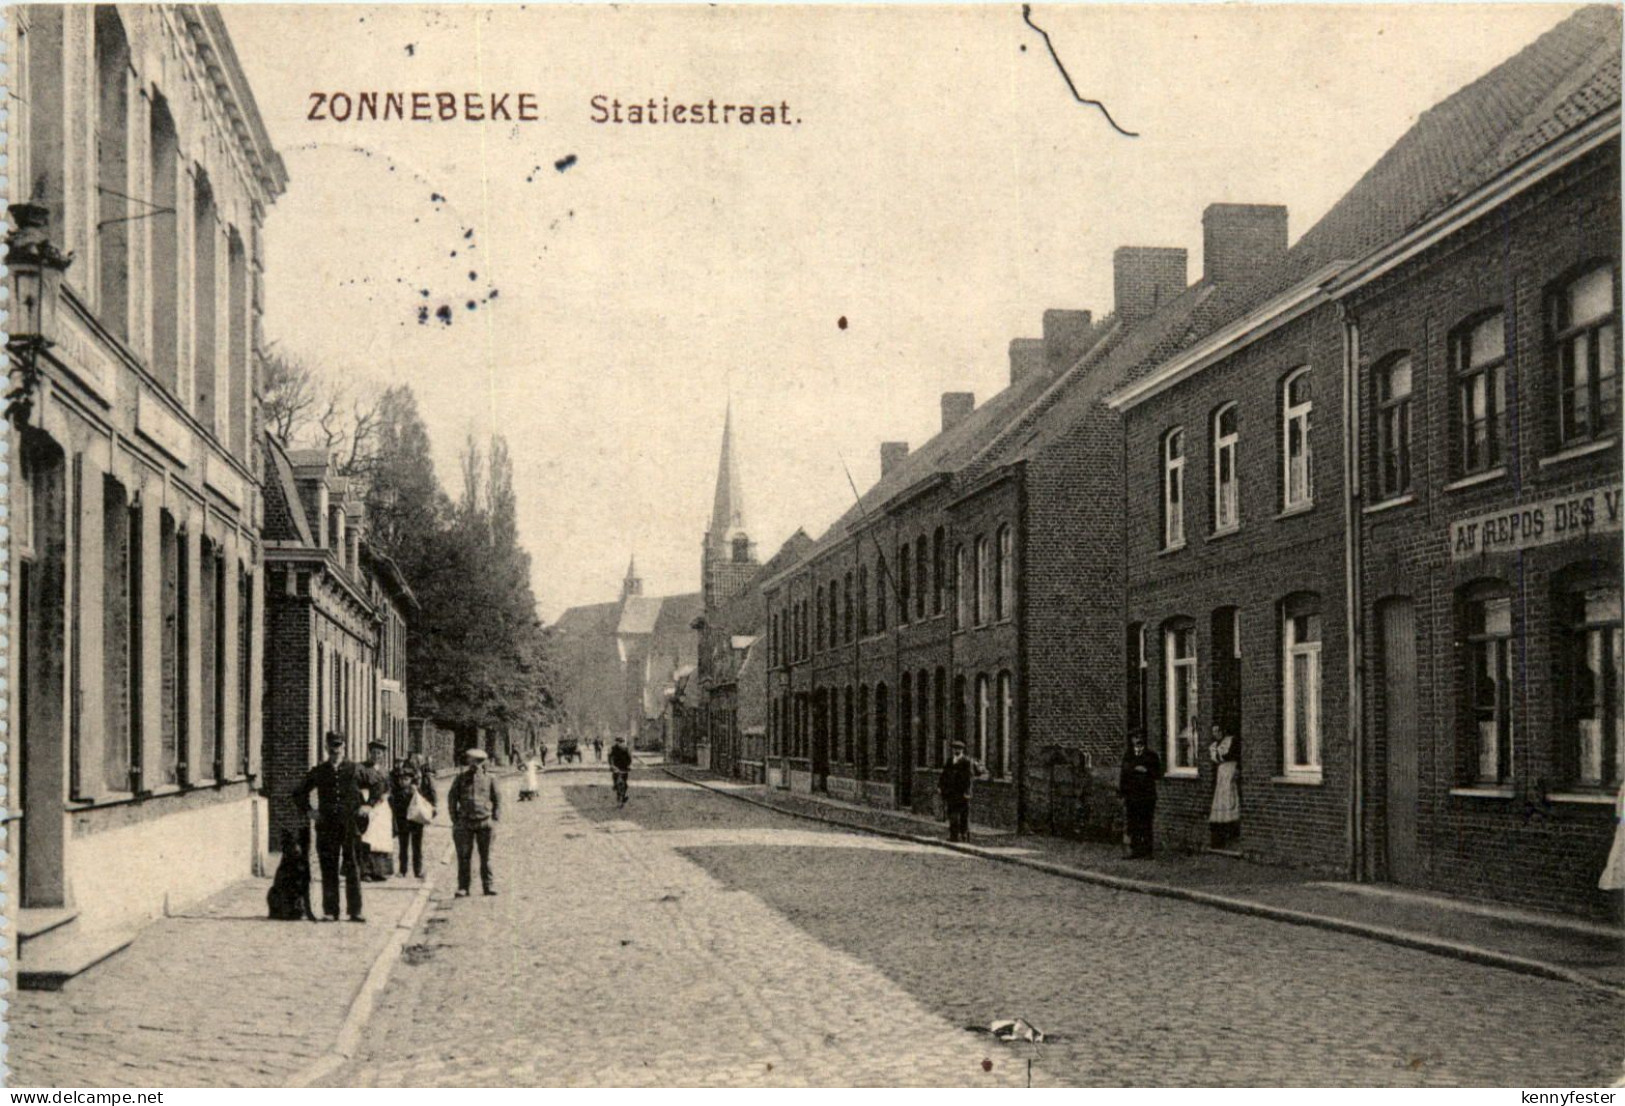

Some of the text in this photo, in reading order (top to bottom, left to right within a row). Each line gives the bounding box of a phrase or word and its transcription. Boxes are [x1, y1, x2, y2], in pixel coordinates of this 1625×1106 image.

[1456, 523, 1478, 551] AU
[1483, 509, 1545, 545] REPOS
[1554, 497, 1596, 532] DES
